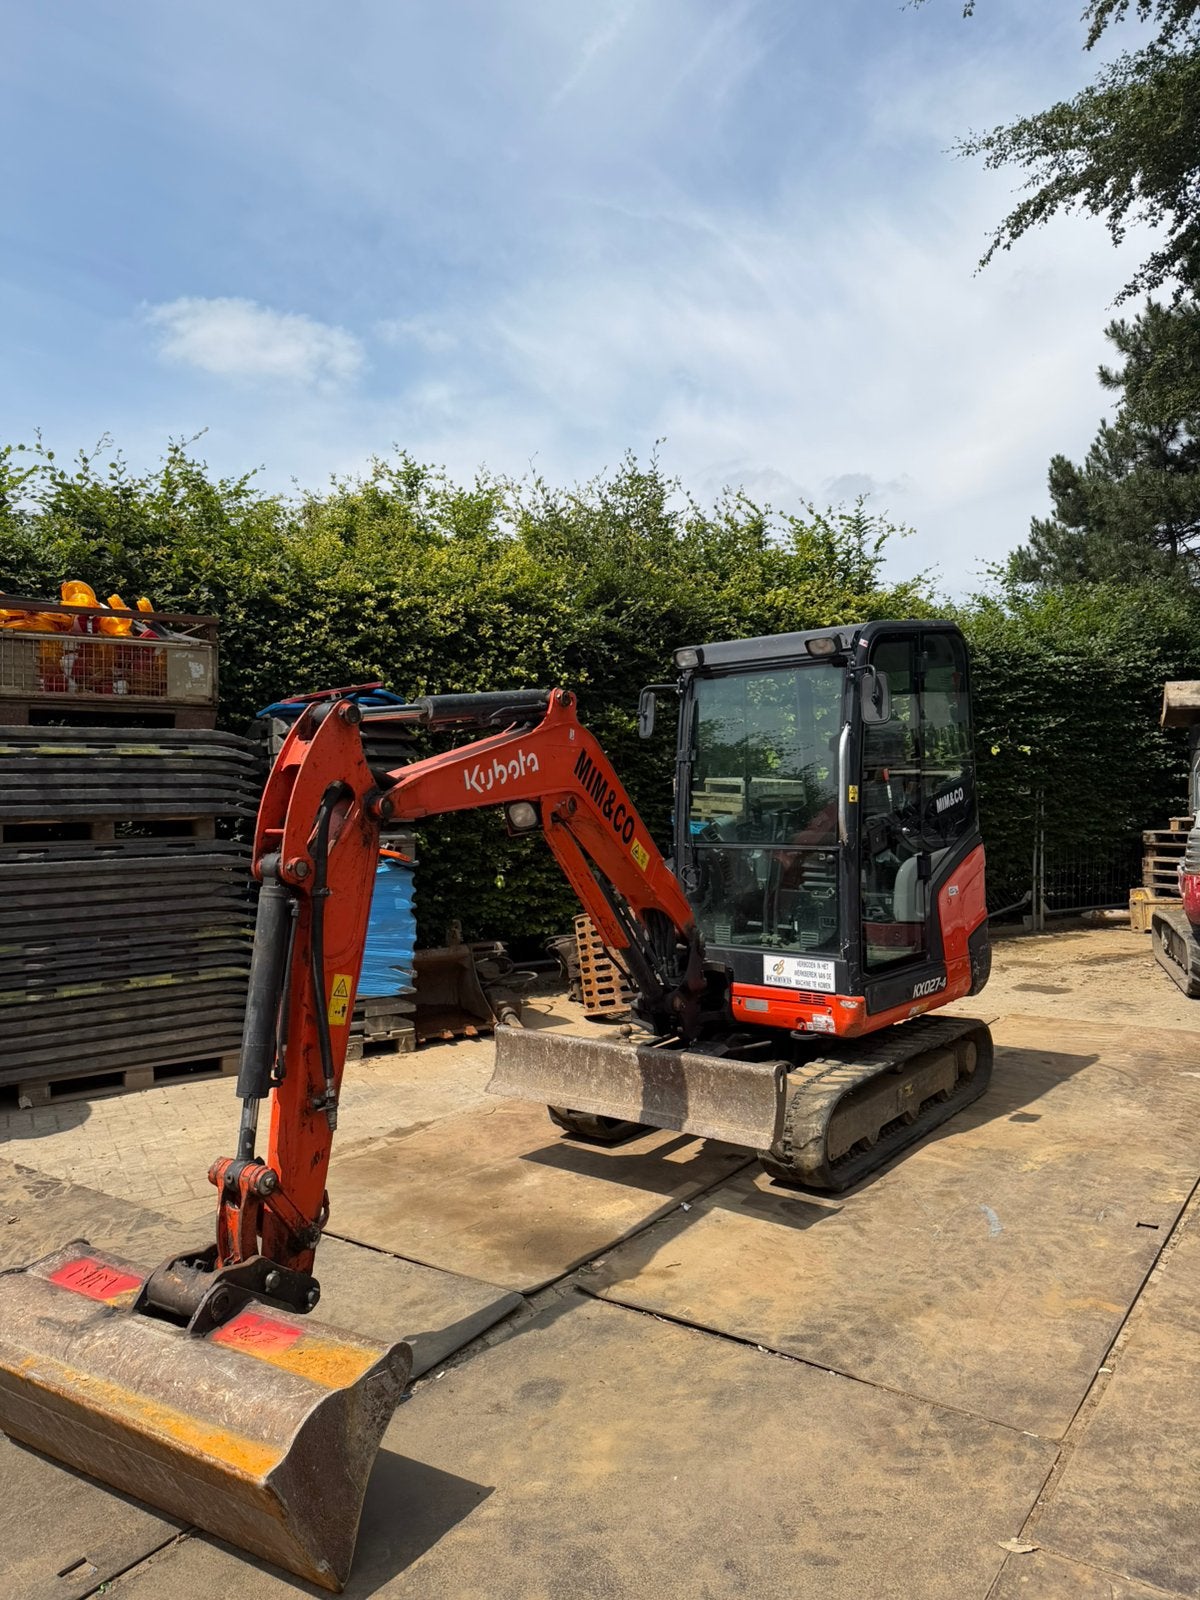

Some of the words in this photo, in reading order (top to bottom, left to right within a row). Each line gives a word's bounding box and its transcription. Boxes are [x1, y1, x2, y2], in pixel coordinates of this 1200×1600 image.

[464, 749, 539, 793] Kubota
[573, 748, 635, 844] MIM&CO
[936, 787, 964, 814] MIM&CO
